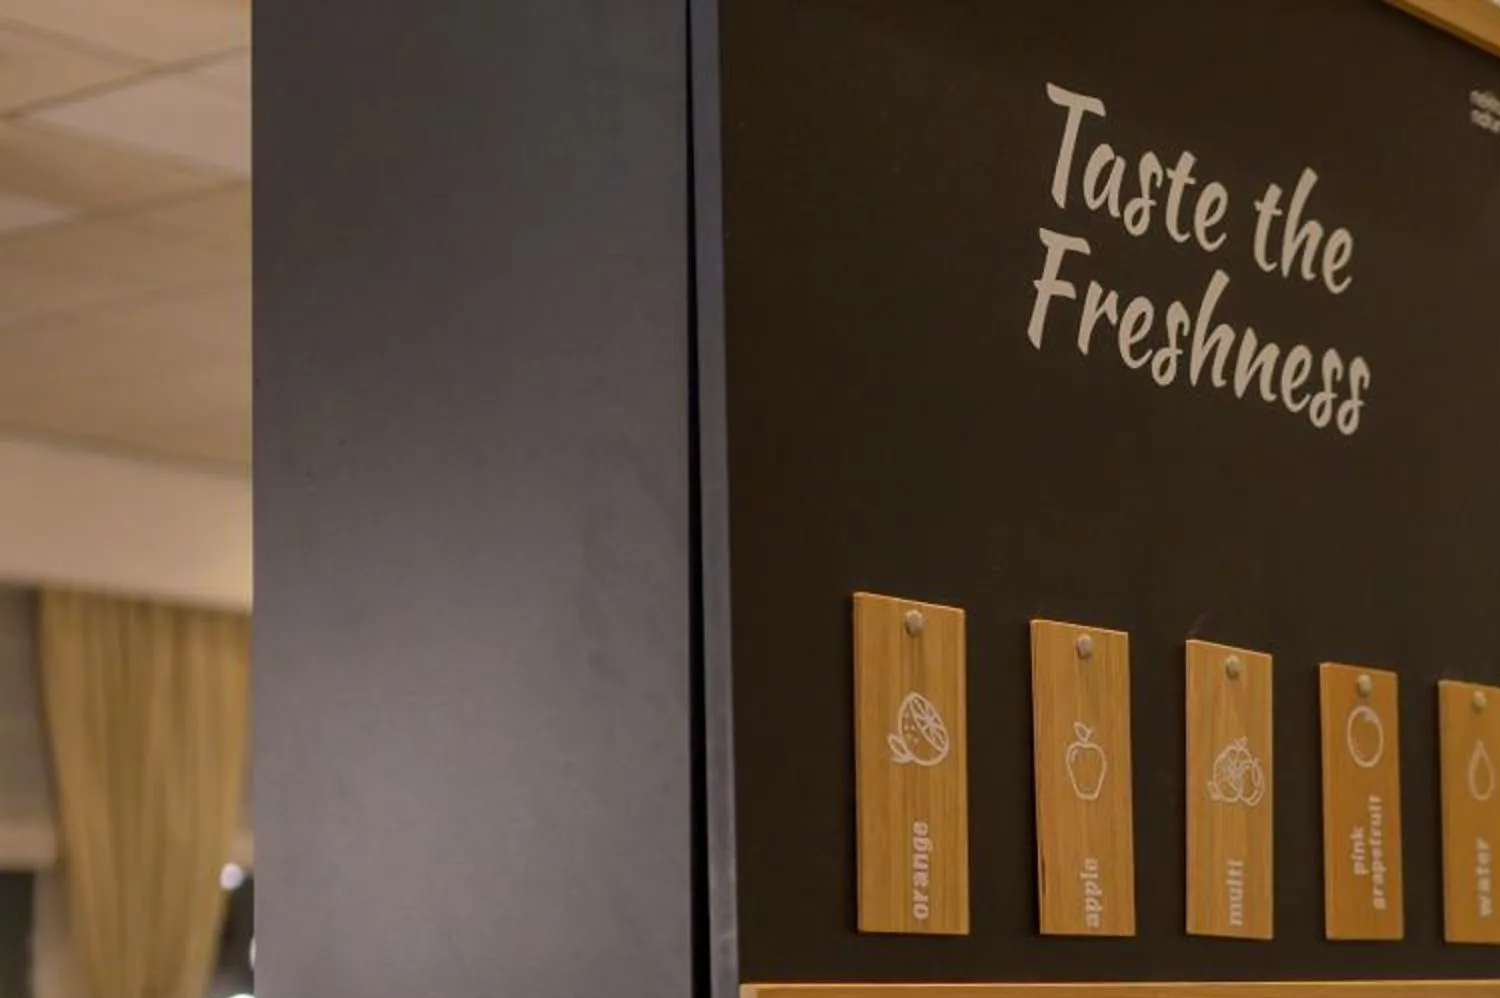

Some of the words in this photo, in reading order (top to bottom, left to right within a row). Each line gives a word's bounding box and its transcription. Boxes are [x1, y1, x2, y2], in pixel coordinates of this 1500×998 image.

[1046, 82, 1228, 251] Taste
[1254, 166, 1354, 294] the
[1027, 227, 1371, 435] Freshness
[912, 821, 932, 920] orange
[1080, 857, 1102, 928] apple
[1225, 858, 1244, 926] multi
[1351, 826, 1369, 876] pink
[1368, 795, 1386, 909] grapefruit
[1475, 837, 1492, 917] water
